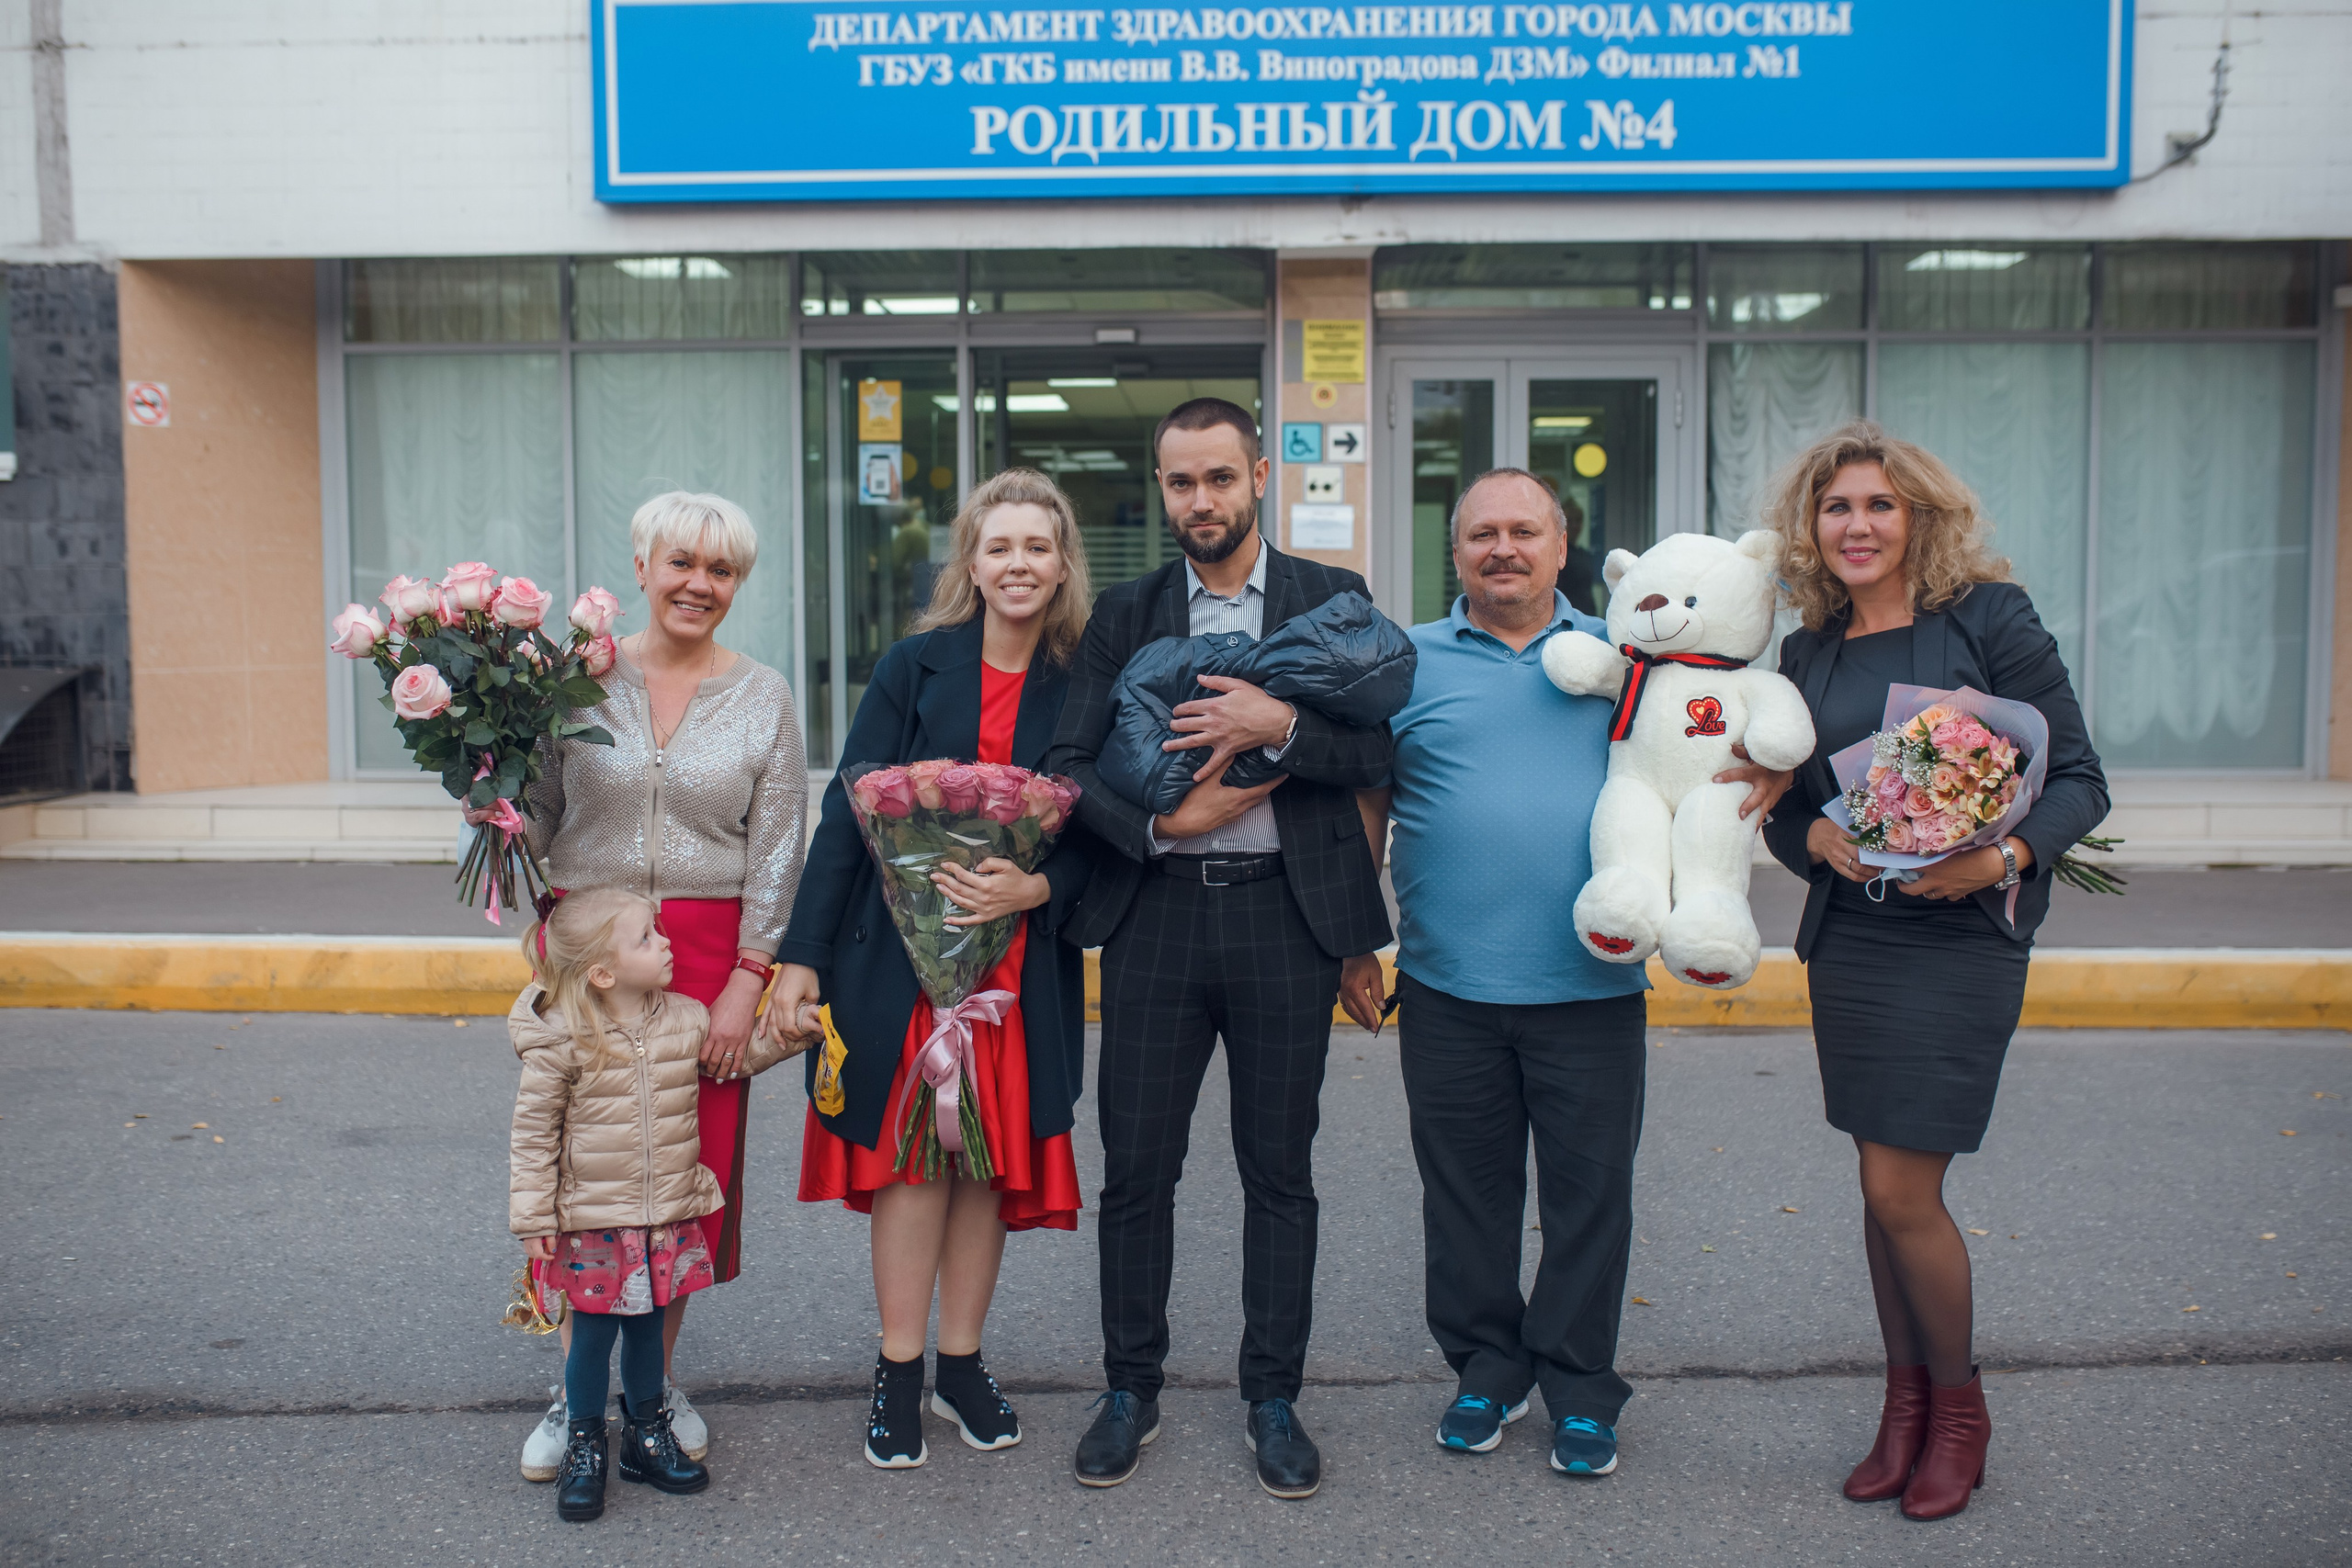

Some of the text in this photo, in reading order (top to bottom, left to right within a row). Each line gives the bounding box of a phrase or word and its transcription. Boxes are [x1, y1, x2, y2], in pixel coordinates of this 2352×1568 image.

[808, 2, 1853, 51] ДЕПАРТАМЕНТ ЗДРАВООХРАНЕНИЯ ГОРОДА МОСКВЫ
[858, 44, 1801, 87] ГБУЗ «ГКБ имени В.В. Виноградова ДЗМ» Филиал №1
[969, 89, 1678, 163] РОДИЛЬНЫЙ ДОМ №4
[1686, 708, 1725, 737] Love
